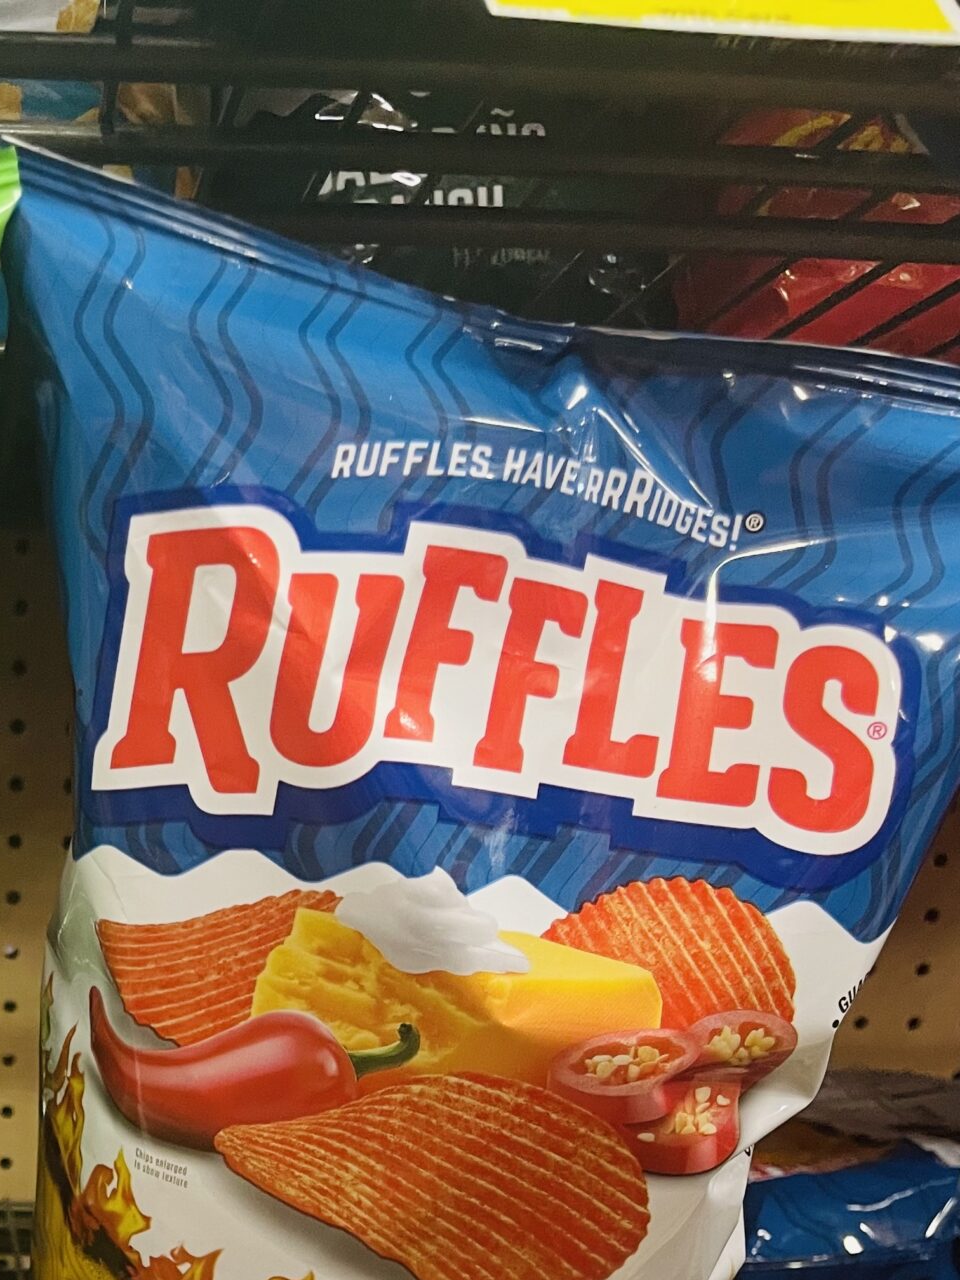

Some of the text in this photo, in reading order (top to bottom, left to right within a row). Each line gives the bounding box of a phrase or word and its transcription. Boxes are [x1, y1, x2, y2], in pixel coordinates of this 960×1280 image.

[332, 441, 493, 480] RUFFLES
[502, 449, 580, 495] HAVE
[110, 525, 881, 834] RUFFLES
[135, 1147, 188, 1176] Chips enlarged
[142, 1164, 160, 1179] show
[162, 1171, 188, 1189] texture
